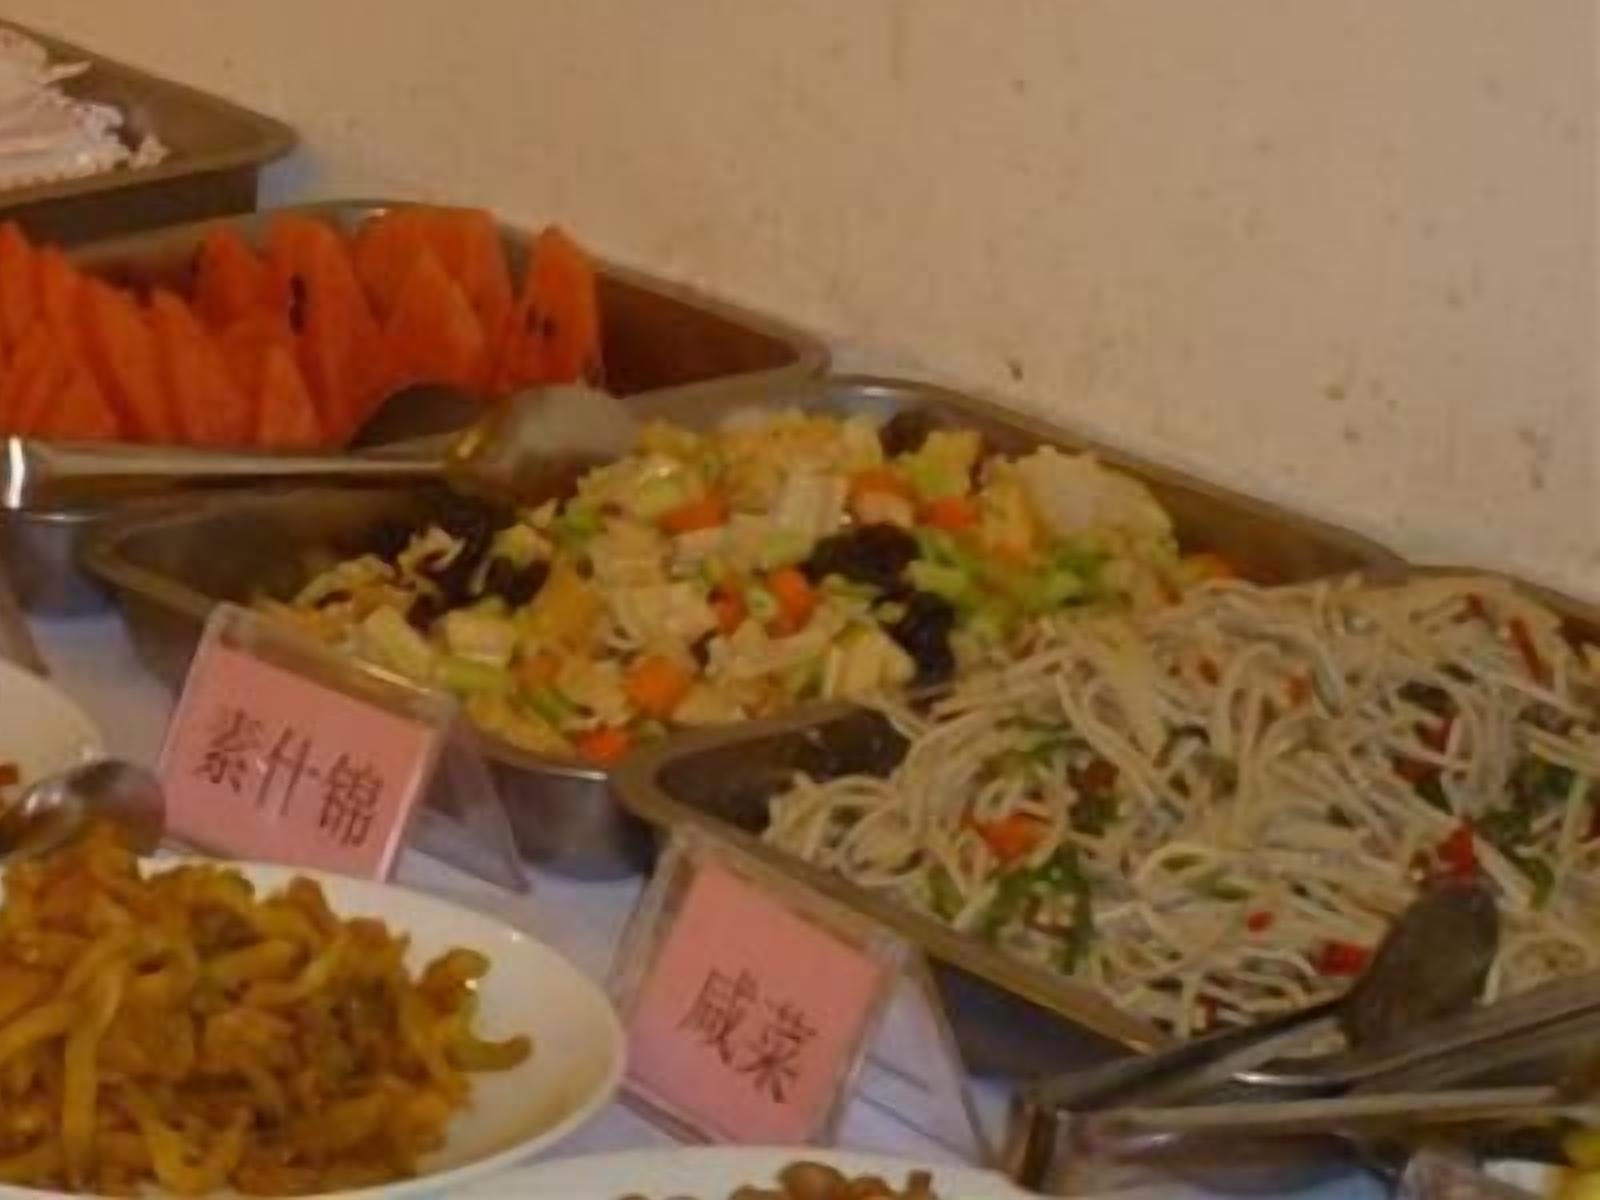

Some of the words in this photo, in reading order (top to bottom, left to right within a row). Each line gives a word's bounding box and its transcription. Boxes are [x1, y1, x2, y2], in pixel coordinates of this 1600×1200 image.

[195, 705, 384, 848] 素什锦
[676, 963, 818, 1105] 咸菜
